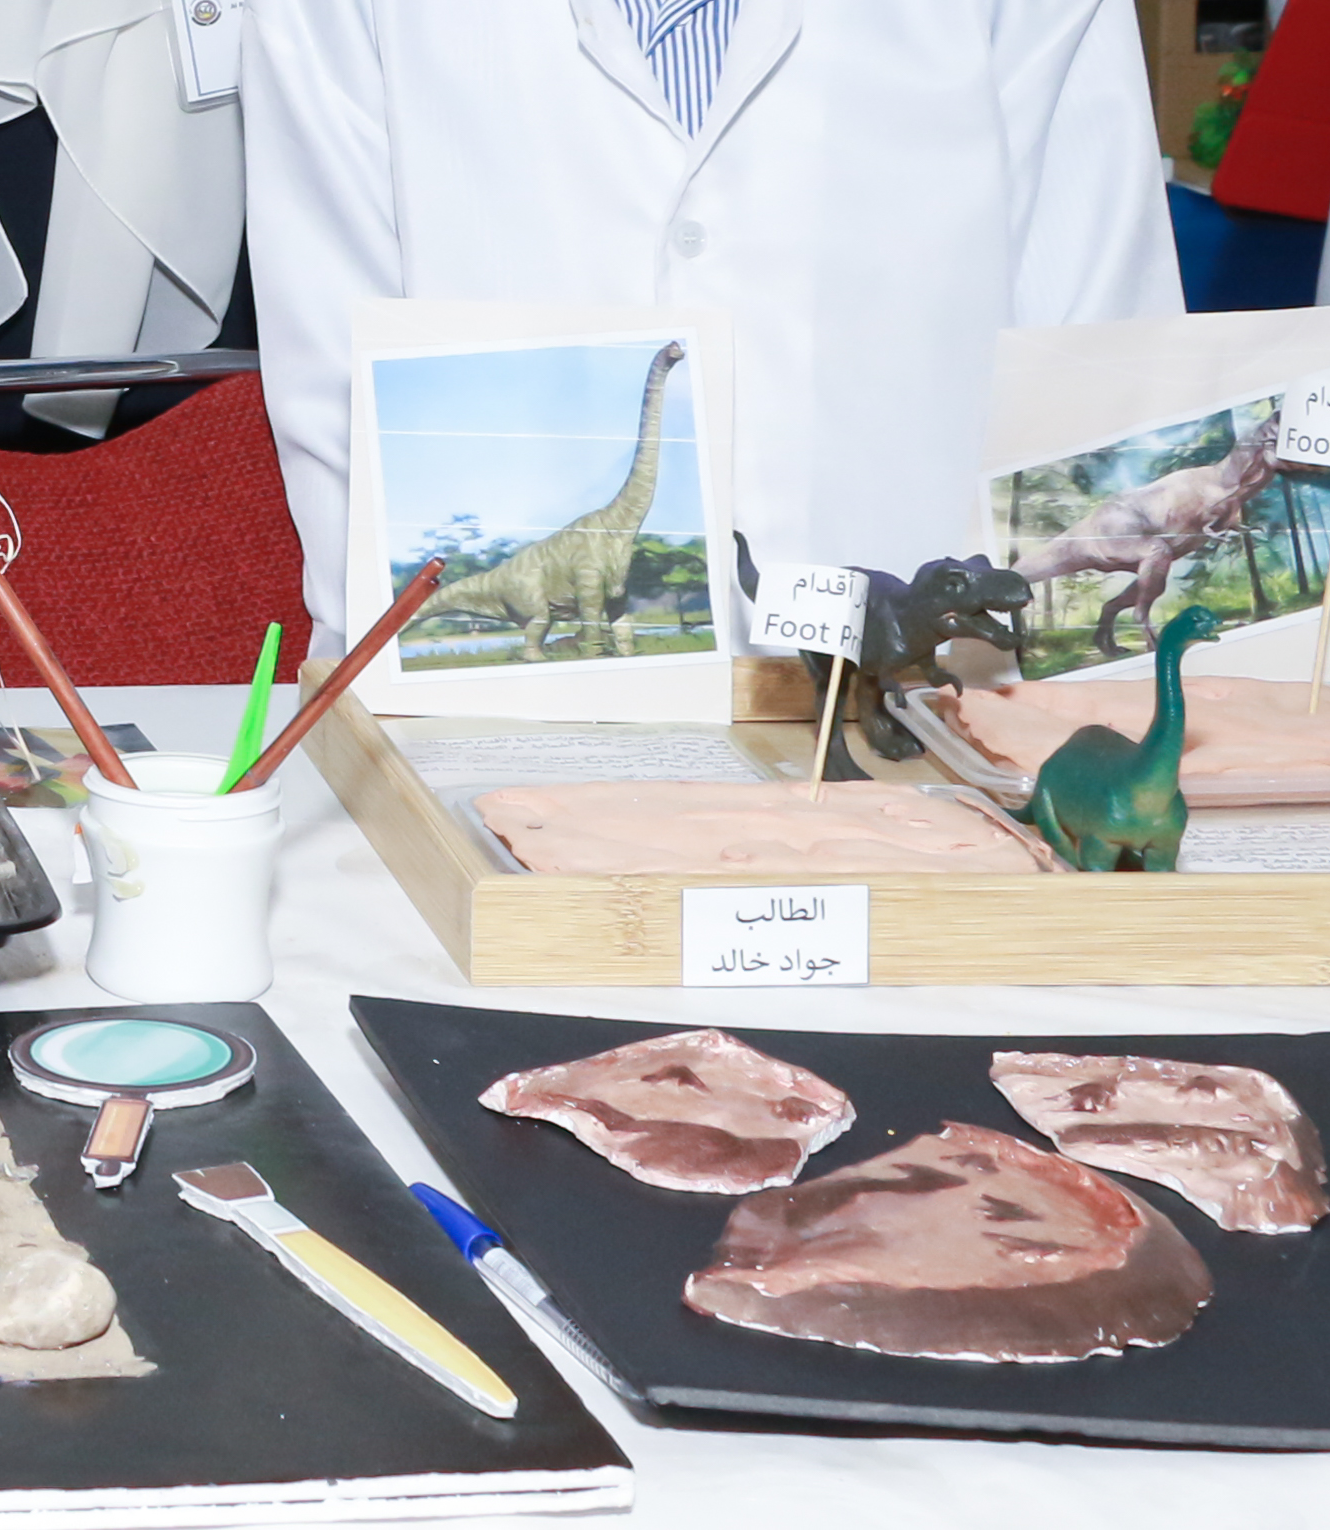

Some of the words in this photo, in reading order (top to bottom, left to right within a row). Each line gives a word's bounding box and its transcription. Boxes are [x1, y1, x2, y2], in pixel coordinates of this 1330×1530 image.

[1286, 426, 1330, 455] Foo
[792, 571, 857, 602] أقدام
[764, 612, 831, 644] Foot
[839, 624, 861, 652] Pr
[735, 896, 826, 931] الطالب
[711, 947, 771, 973] خالد
[779, 947, 841, 981] جواد
